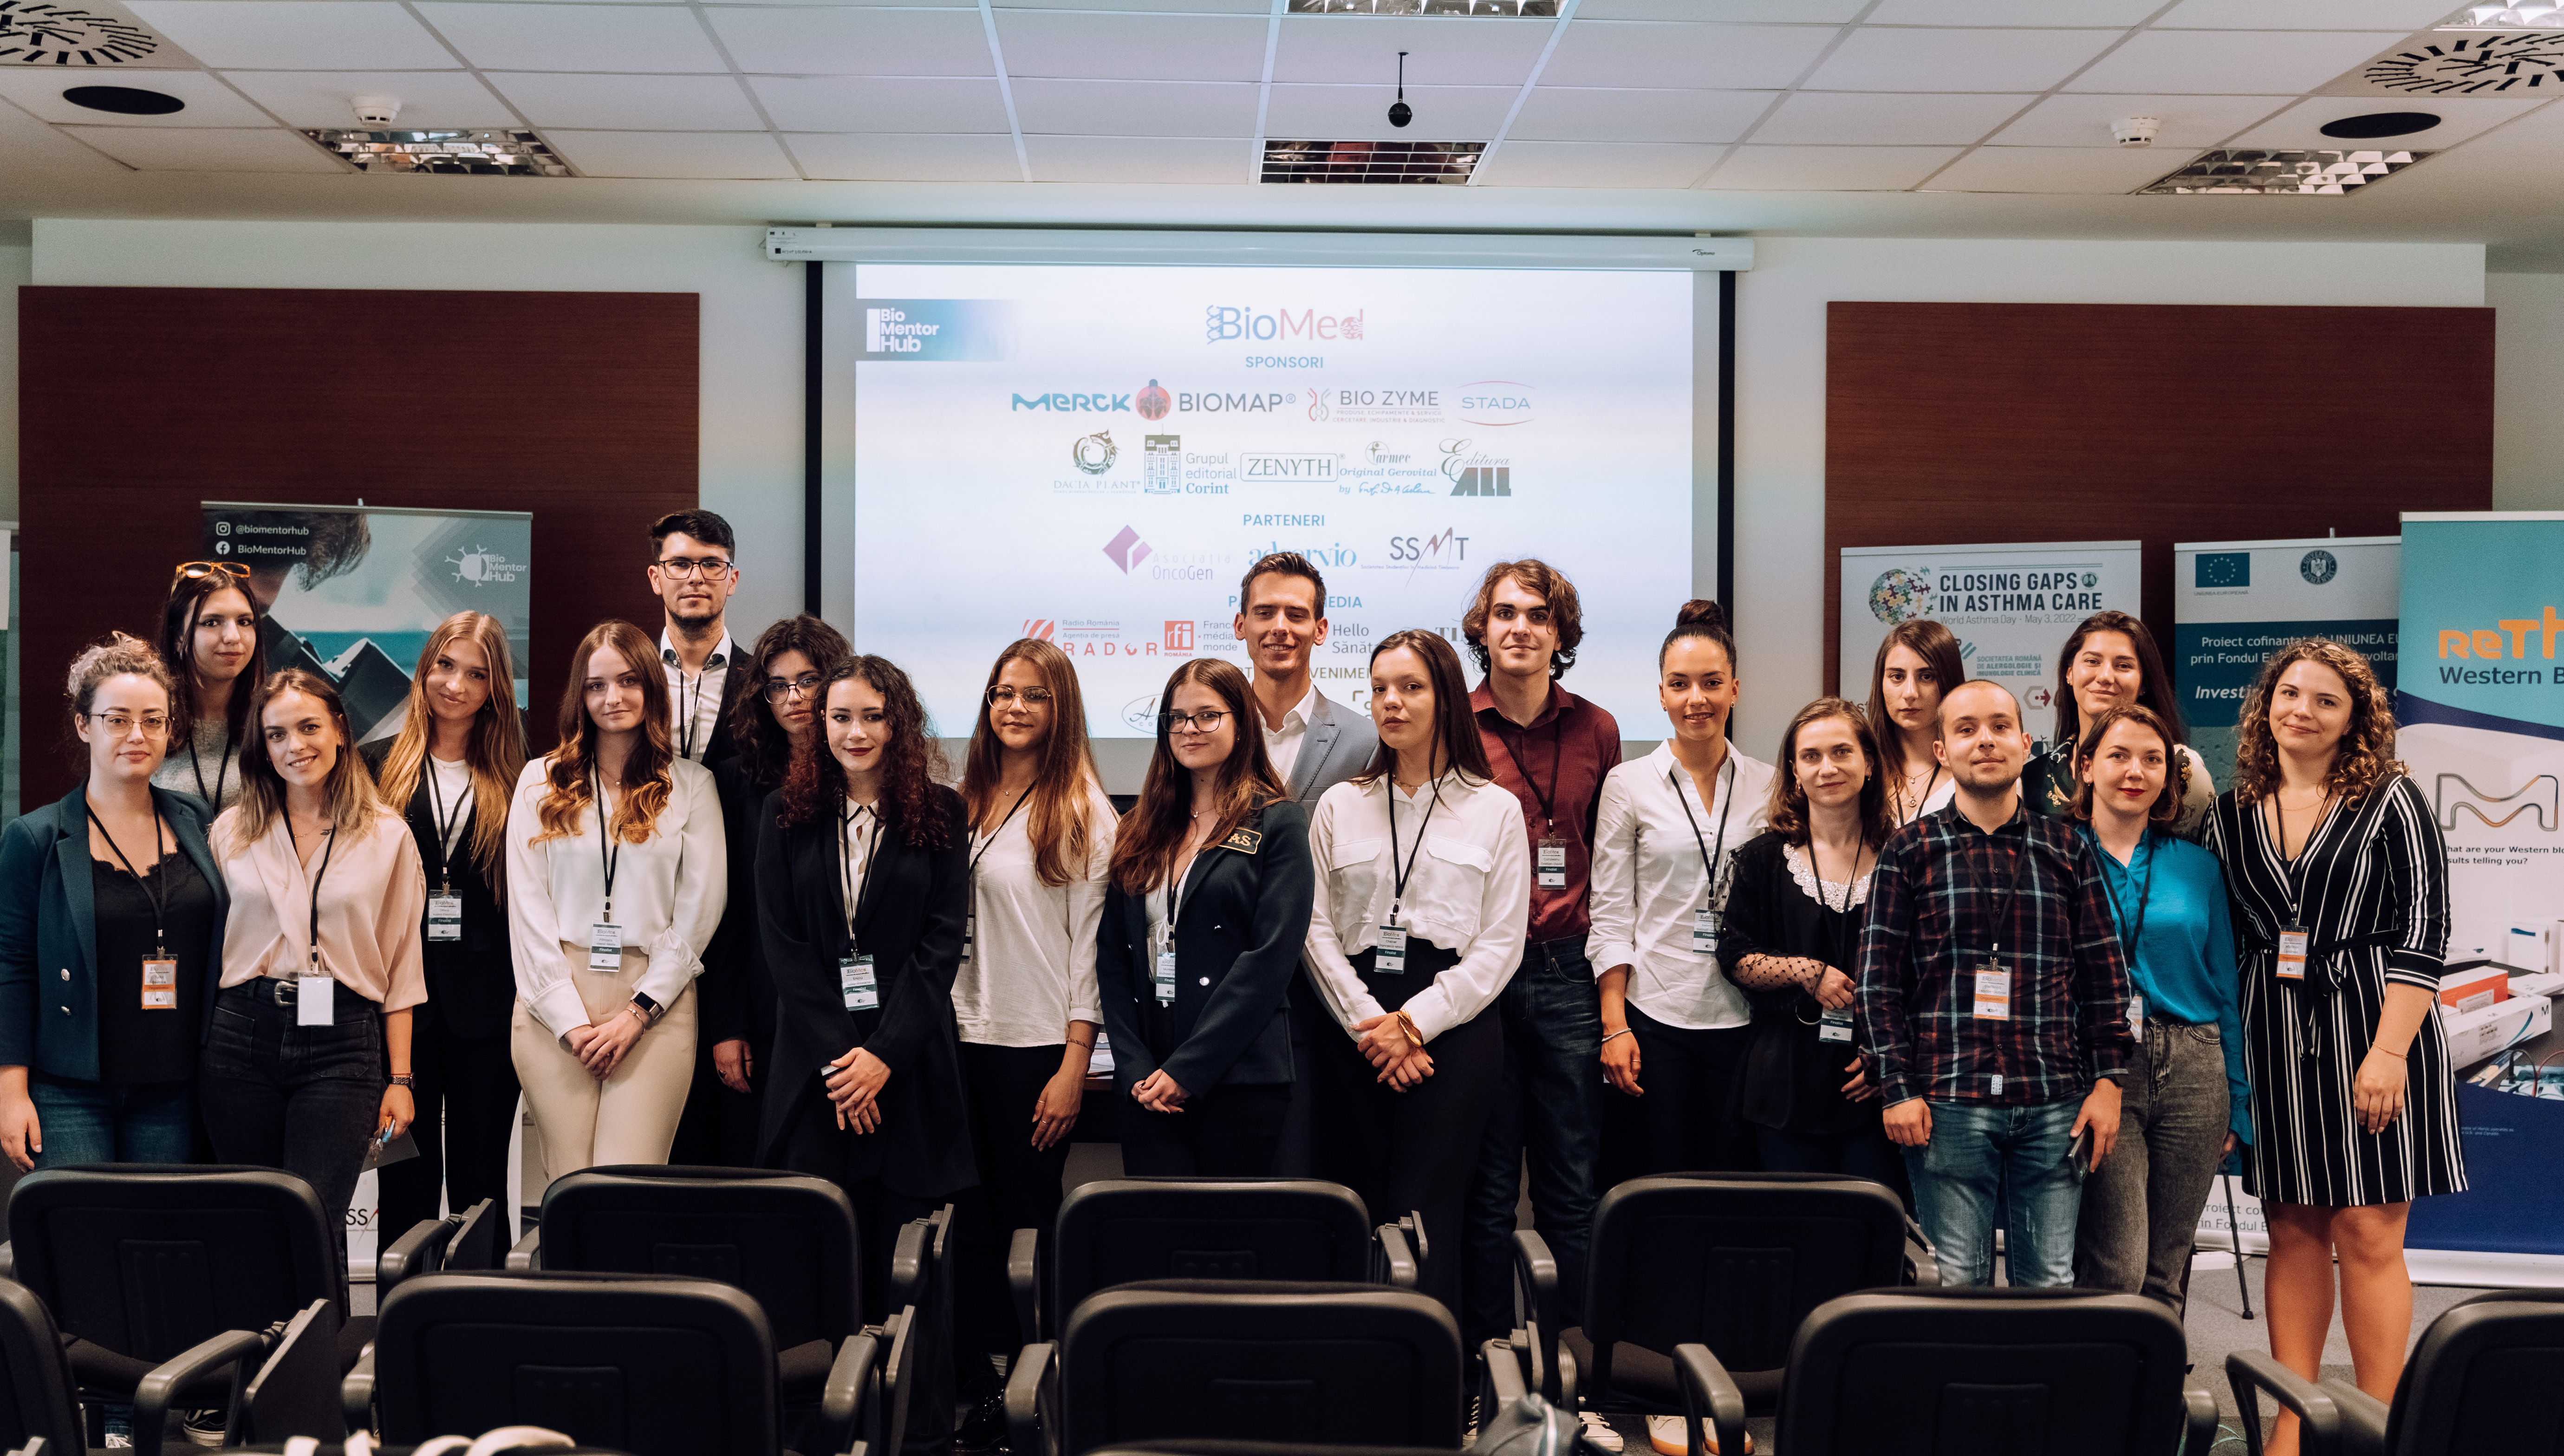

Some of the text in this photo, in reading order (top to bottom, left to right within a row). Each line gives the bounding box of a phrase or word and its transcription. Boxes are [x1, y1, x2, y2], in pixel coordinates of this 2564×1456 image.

[881, 307, 905, 322] Bio
[881, 322, 939, 335] Mentor
[1219, 306, 1364, 340] BioMed
[881, 335, 921, 352] Hub
[1245, 356, 1324, 368] SPONSORI
[1012, 393, 1130, 412] MERCK
[1341, 390, 1439, 406] BIO ZYME
[1462, 397, 1530, 409] STADA
[1186, 453, 1228, 466] Grupul
[1439, 438, 1510, 482] Editura
[1247, 458, 1331, 476] ZENYTH
[1340, 468, 1437, 478] Original Gerovital
[1186, 468, 1236, 479] editorial
[1450, 467, 1511, 496] ALL
[1186, 482, 1229, 494] Corint
[1339, 485, 1350, 494] by
[1243, 514, 1324, 526] PARTENERI
[235, 525, 309, 535] @biomentorhub
[238, 545, 306, 555] BioMentorHub
[1389, 527, 1469, 570] SSMT
[490, 554, 505, 563] Bio
[490, 563, 527, 572] Mentor
[1153, 566, 1212, 580] OncoGen
[490, 571, 515, 581] Hub
[1940, 572, 2077, 592] CLOSING GAPS
[1325, 596, 1362, 608] EDIA
[1940, 592, 2102, 612] IN ASTHMA CARE
[1940, 615, 1964, 624] World
[1965, 615, 1998, 624] Asthma
[2000, 615, 2017, 625] Day
[2024, 614, 2043, 624] May
[2053, 613, 2076, 623] 2022
[1167, 624, 1191, 647] rfi
[1333, 624, 1369, 636] Hello
[1204, 643, 1237, 651] monde
[2202, 637, 2243, 647] Proiect
[1063, 642, 1158, 656] RADOR
[2191, 654, 2213, 666] prin
[2218, 652, 2258, 663] Fondul
[2440, 666, 2541, 684] Western
[2473, 858, 2502, 866] telling
[2216, 1219, 2257, 1230] Fodul
